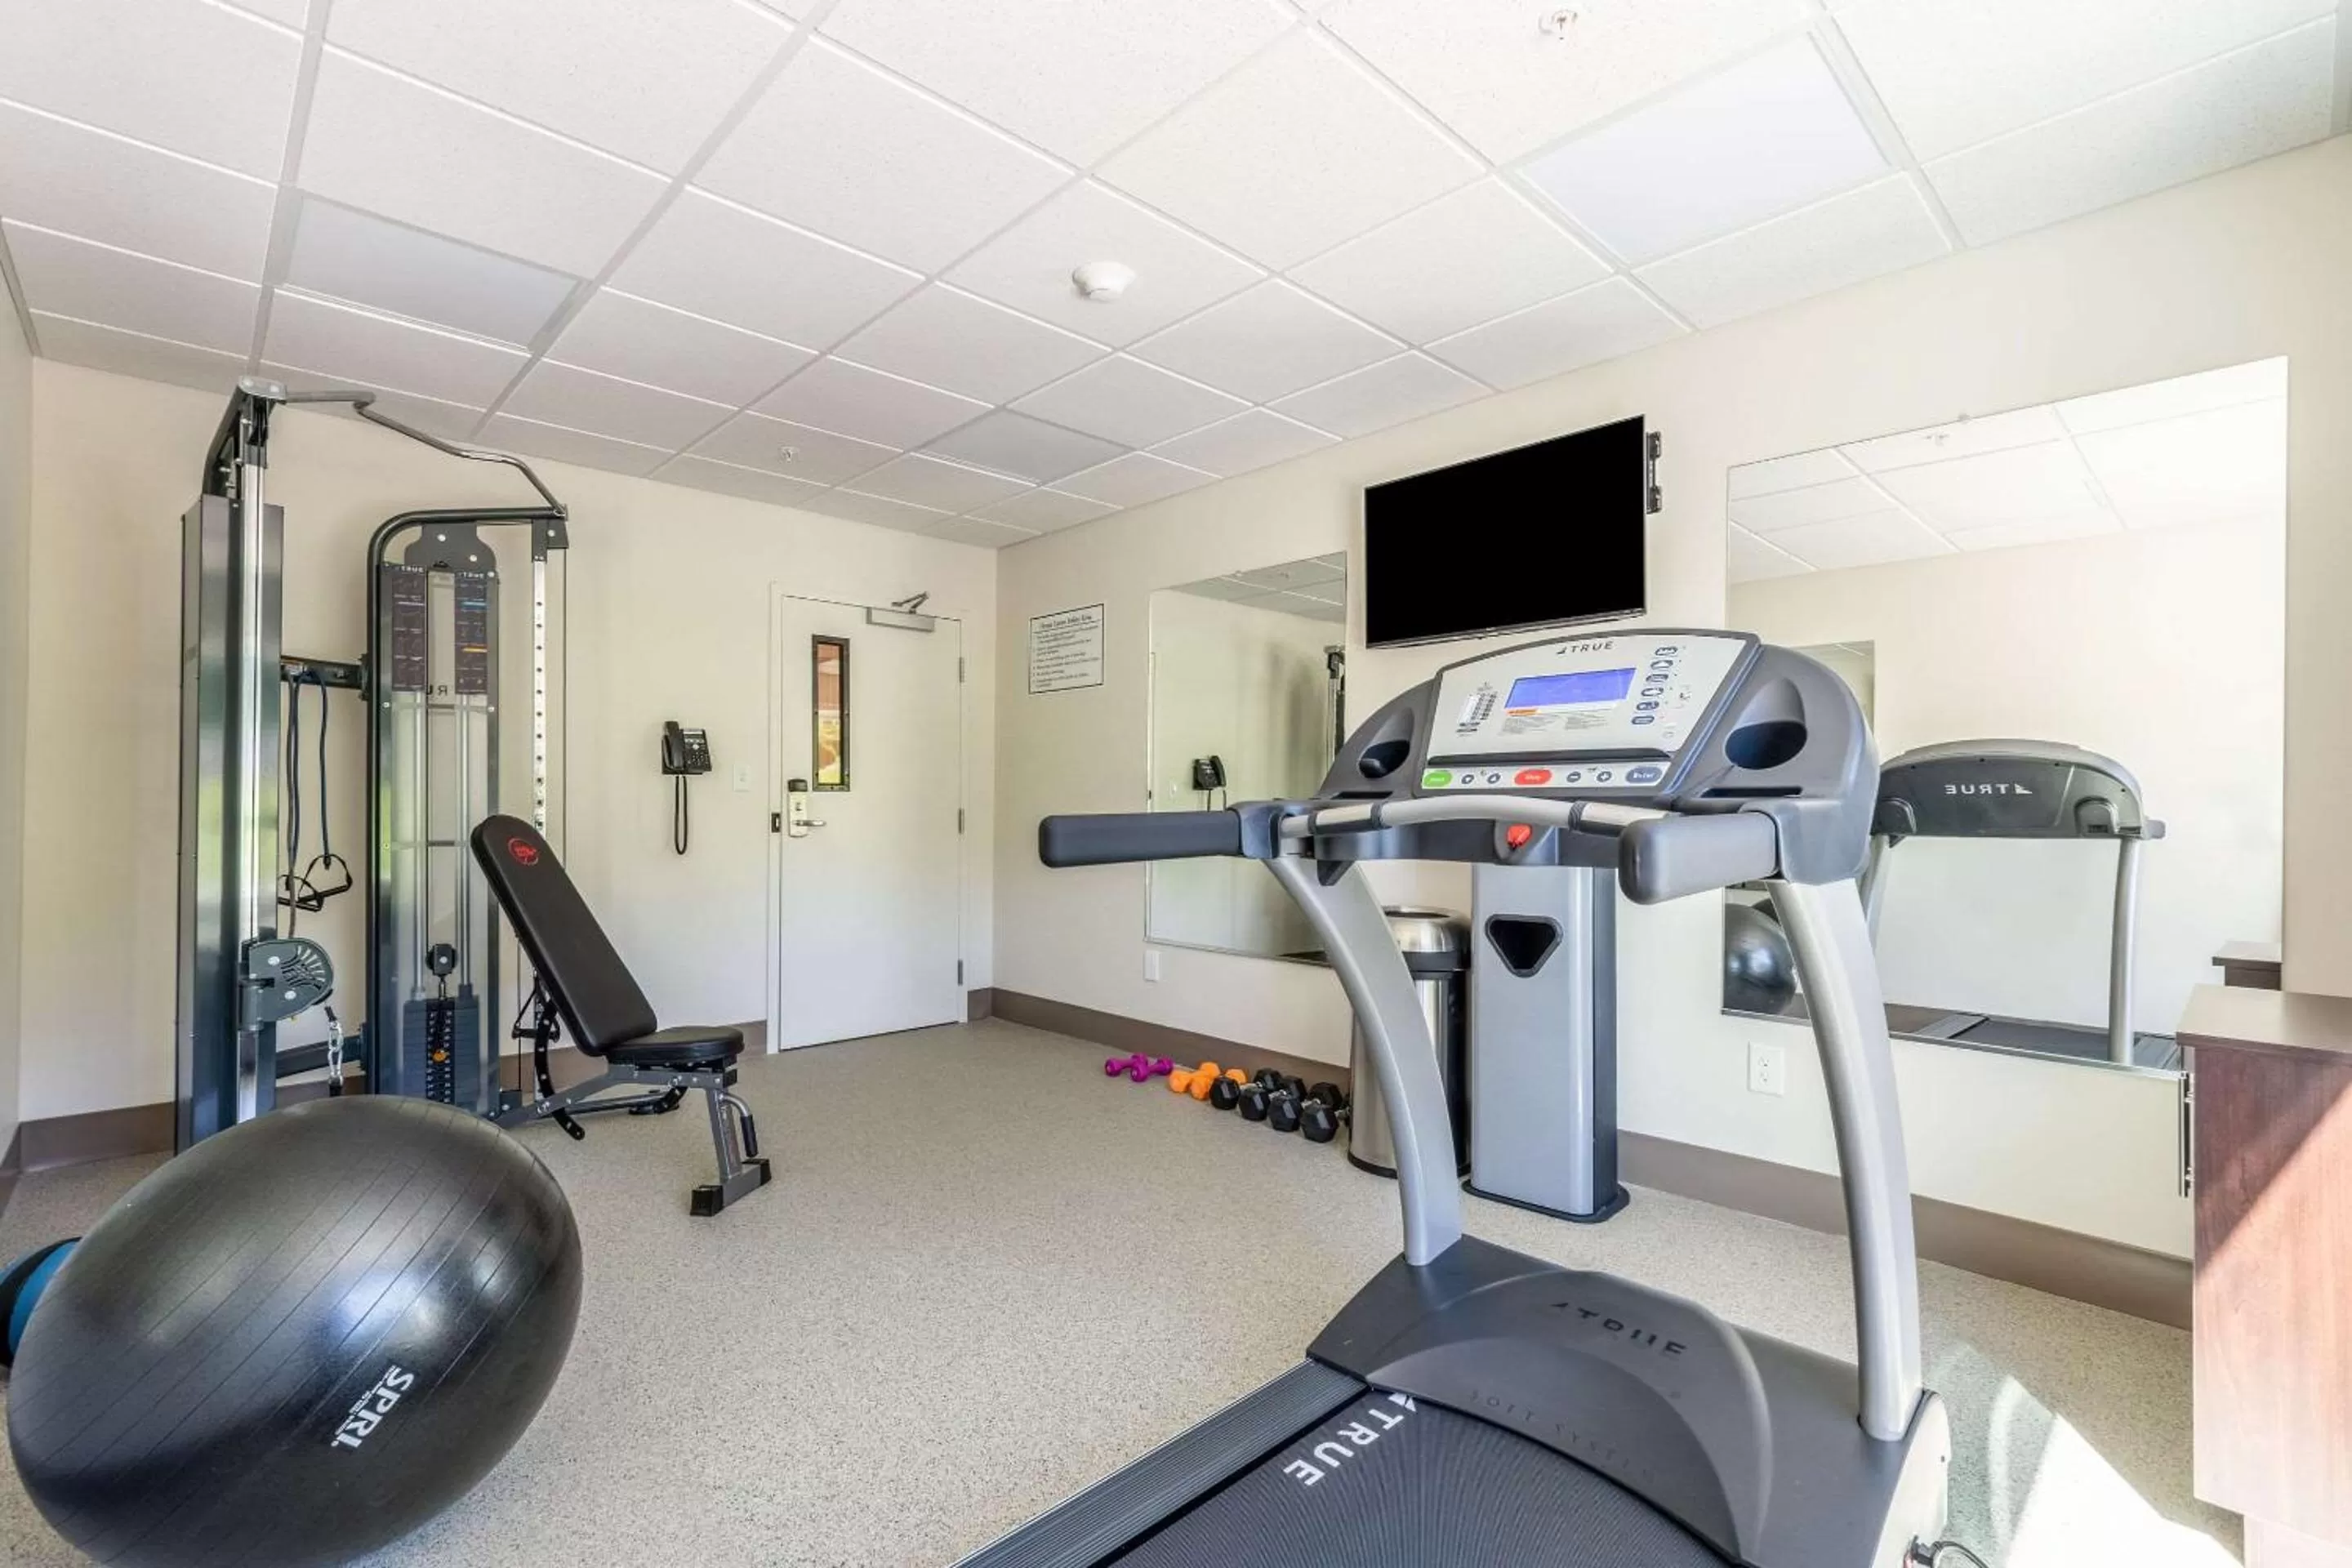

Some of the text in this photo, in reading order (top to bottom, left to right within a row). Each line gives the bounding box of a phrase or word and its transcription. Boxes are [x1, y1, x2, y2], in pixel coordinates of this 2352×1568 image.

[1570, 640, 1614, 653] TRUE
[336, 1365, 415, 1448] SPRI
[1282, 1400, 1405, 1486] TRUE
